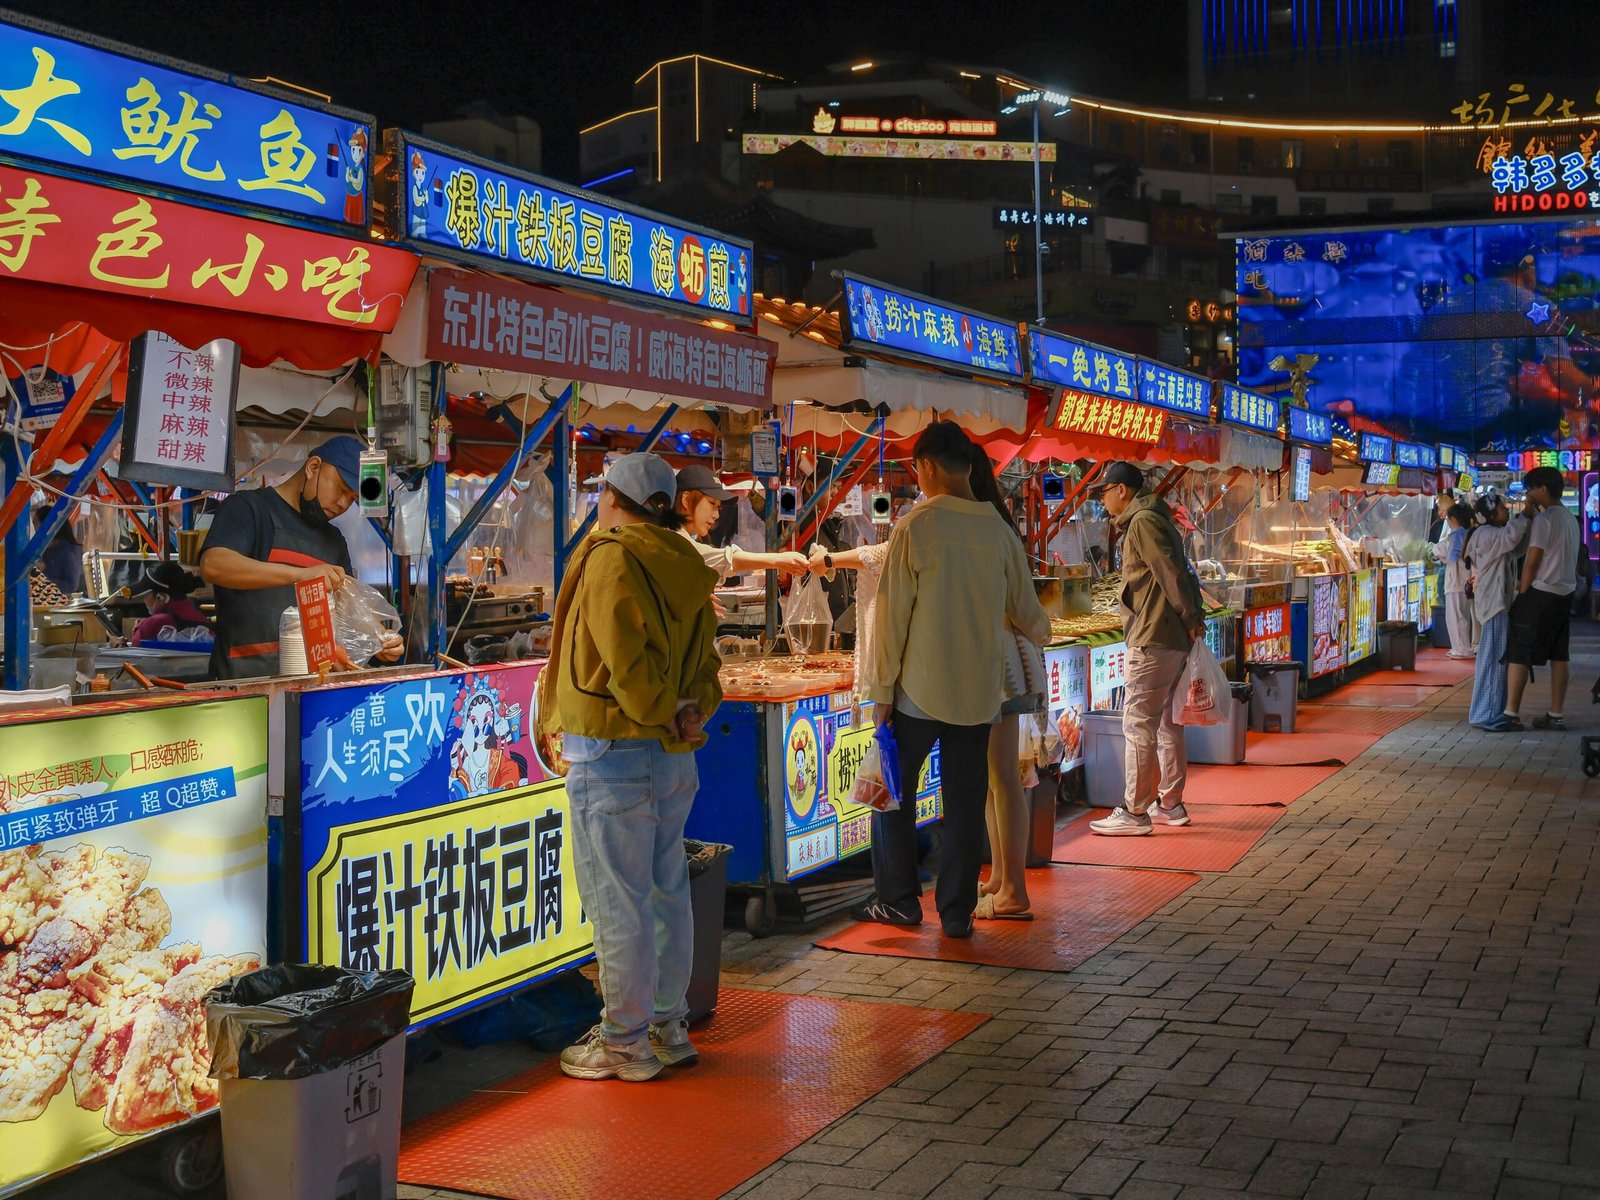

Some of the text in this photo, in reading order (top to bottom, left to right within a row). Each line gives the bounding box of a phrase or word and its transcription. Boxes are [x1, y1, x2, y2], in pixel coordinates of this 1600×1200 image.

[0, 46, 326, 204] 大鱿鱼
[1492, 152, 1600, 193] 韩多多
[0, 177, 380, 324] 特色小吃
[446, 168, 731, 310] 爆汁铁板豆腐 海蛎煎
[166, 349, 215, 374] 不辣
[1049, 347, 1132, 397] 一绝烤鱼
[162, 391, 212, 414] 中辣
[164, 371, 213, 394] 微辣
[1157, 372, 1203, 411] 云南昆虫宴
[160, 413, 209, 438] 麻辣
[1058, 391, 1163, 443] 朝鲜族特色烤明太鱼
[157, 438, 207, 464] 甜辣
[336, 808, 563, 982] 爆汁铁板豆腐
[348, 1049, 384, 1071] HERE
